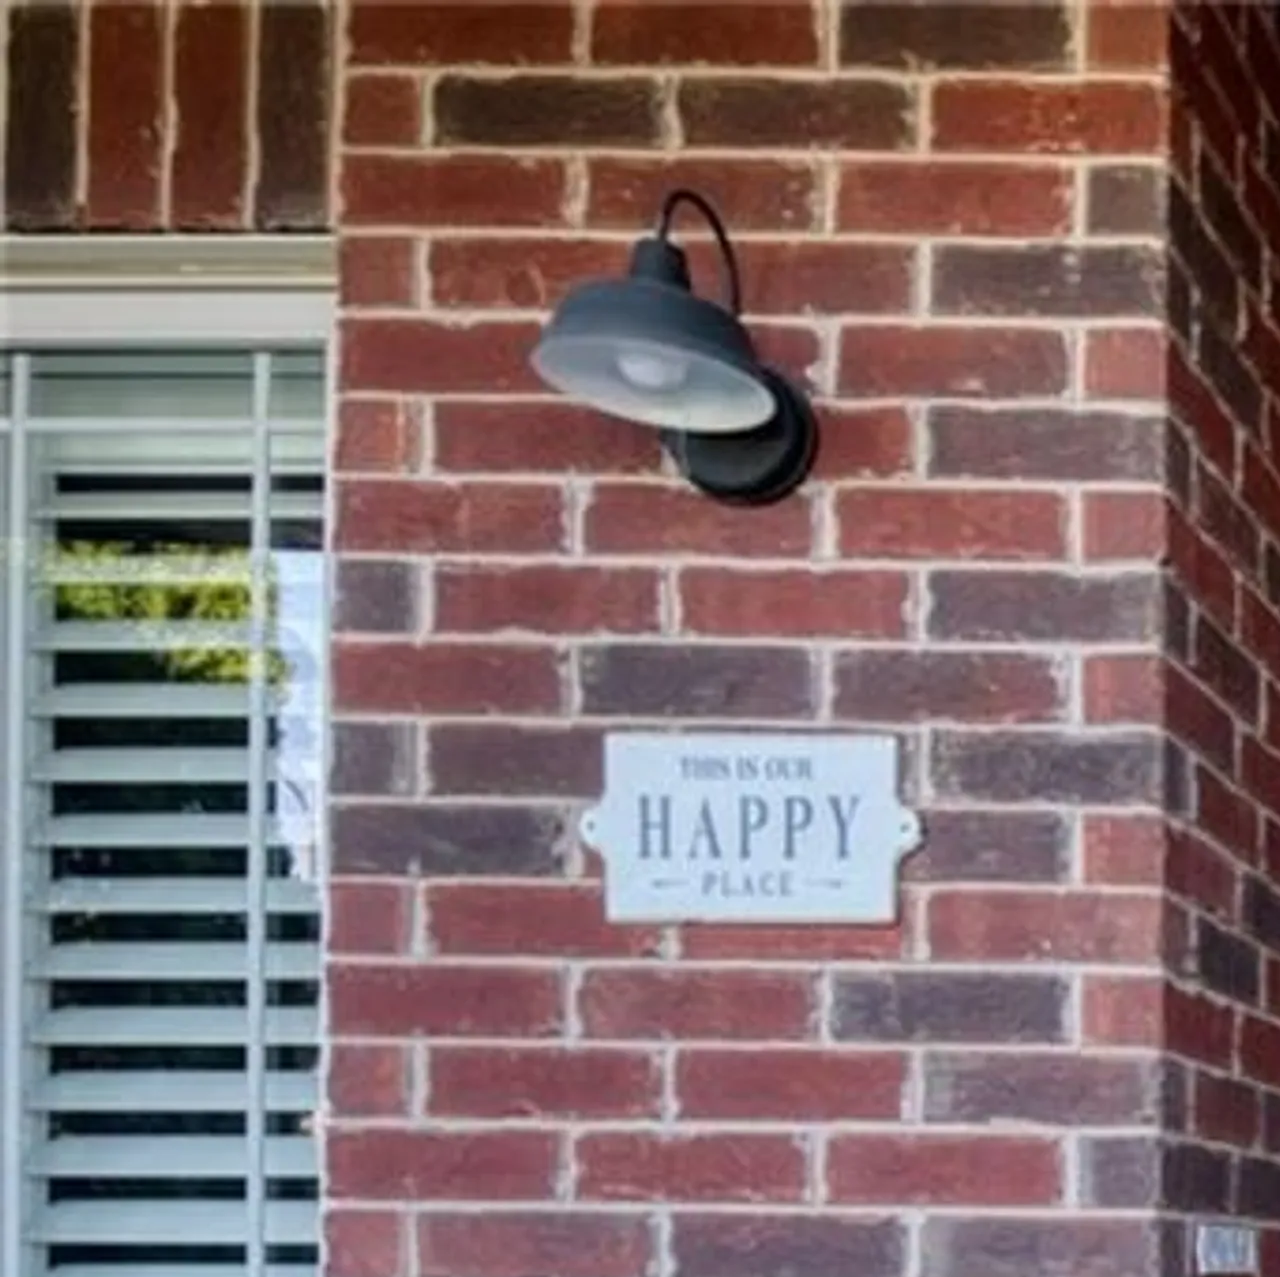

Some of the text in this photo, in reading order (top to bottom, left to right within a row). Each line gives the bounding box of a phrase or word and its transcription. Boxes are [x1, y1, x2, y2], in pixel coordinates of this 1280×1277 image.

[680, 756, 814, 781] THIS IS OUR
[637, 795, 860, 860] HAPPY
[700, 871, 795, 897] PLACE
